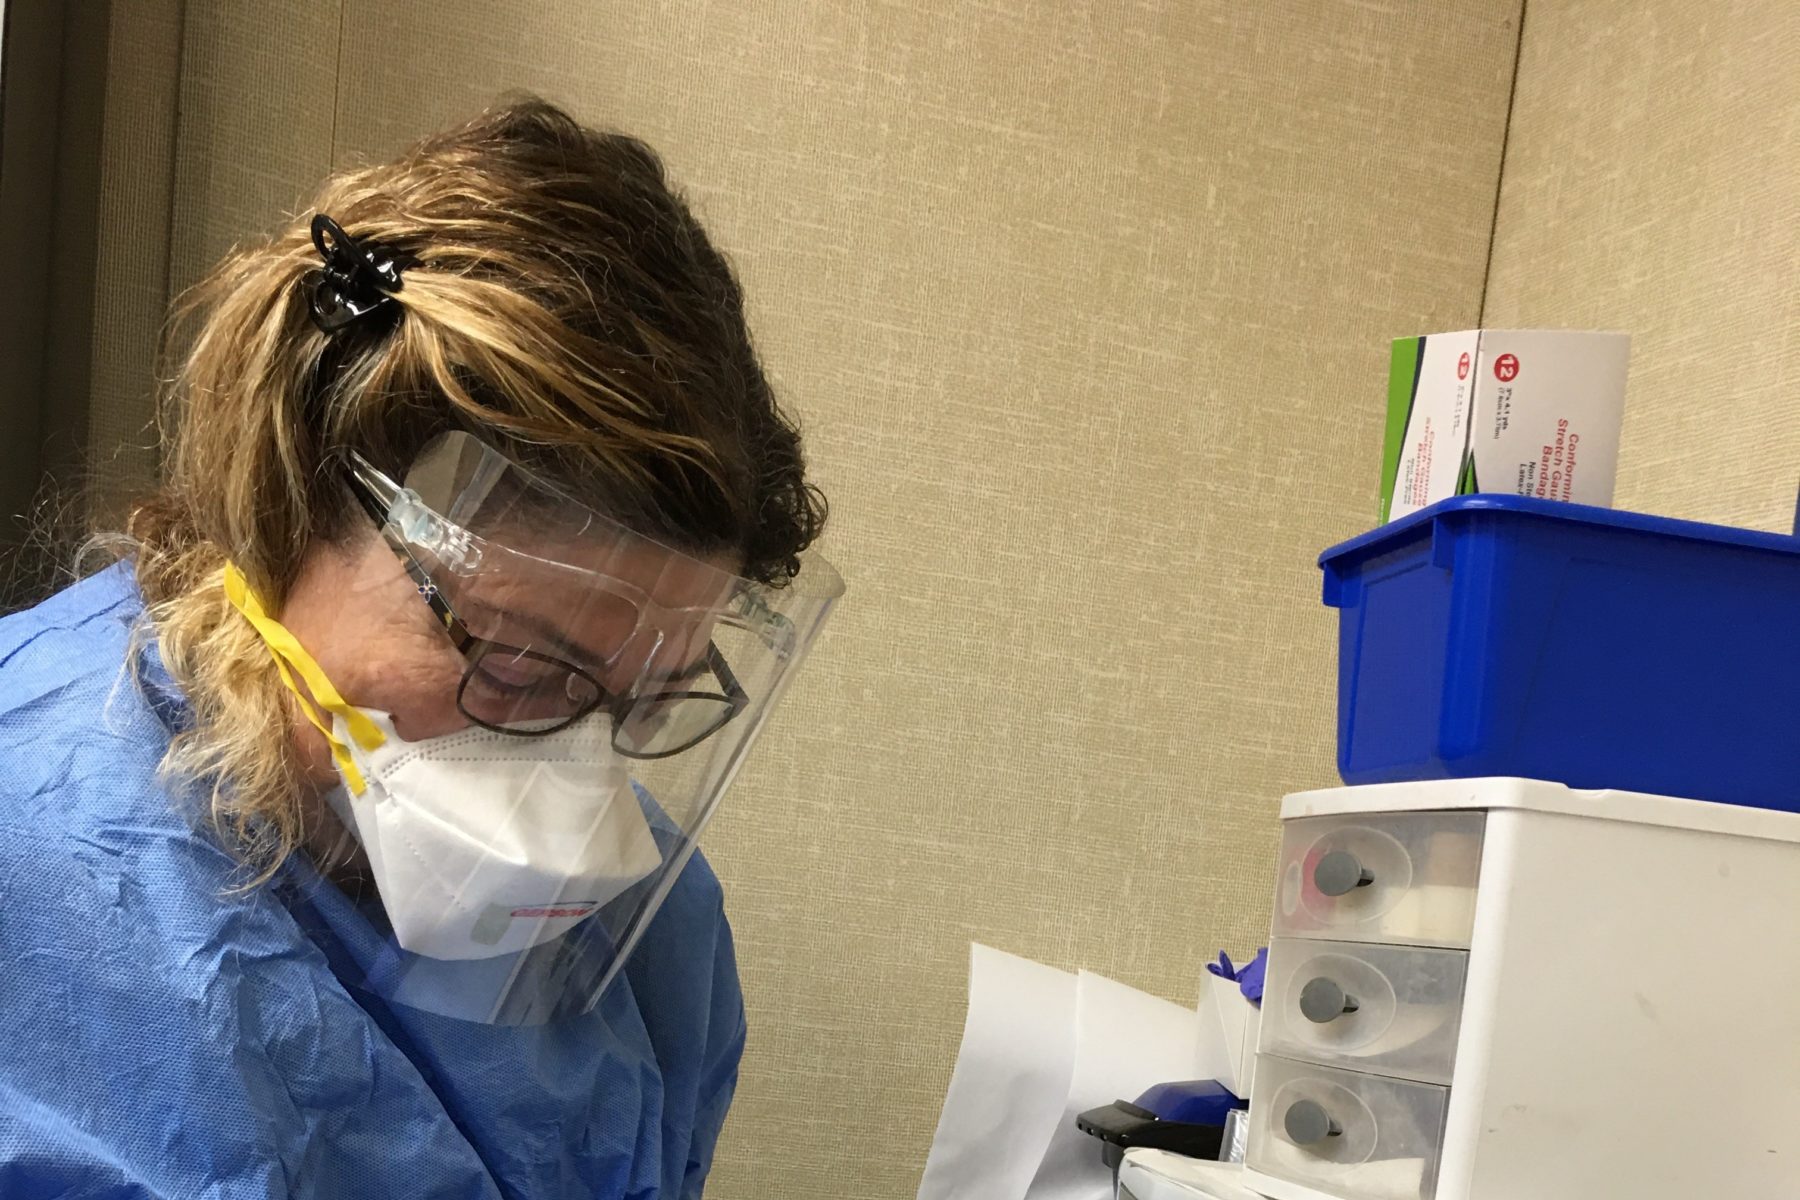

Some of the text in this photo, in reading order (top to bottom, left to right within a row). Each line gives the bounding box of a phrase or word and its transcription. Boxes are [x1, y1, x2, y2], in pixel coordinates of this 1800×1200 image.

[1500, 355, 1515, 378] 12
[1553, 418, 1568, 466] Stretch
[1528, 461, 1537, 480] Non
[1536, 445, 1553, 499] Bandag
